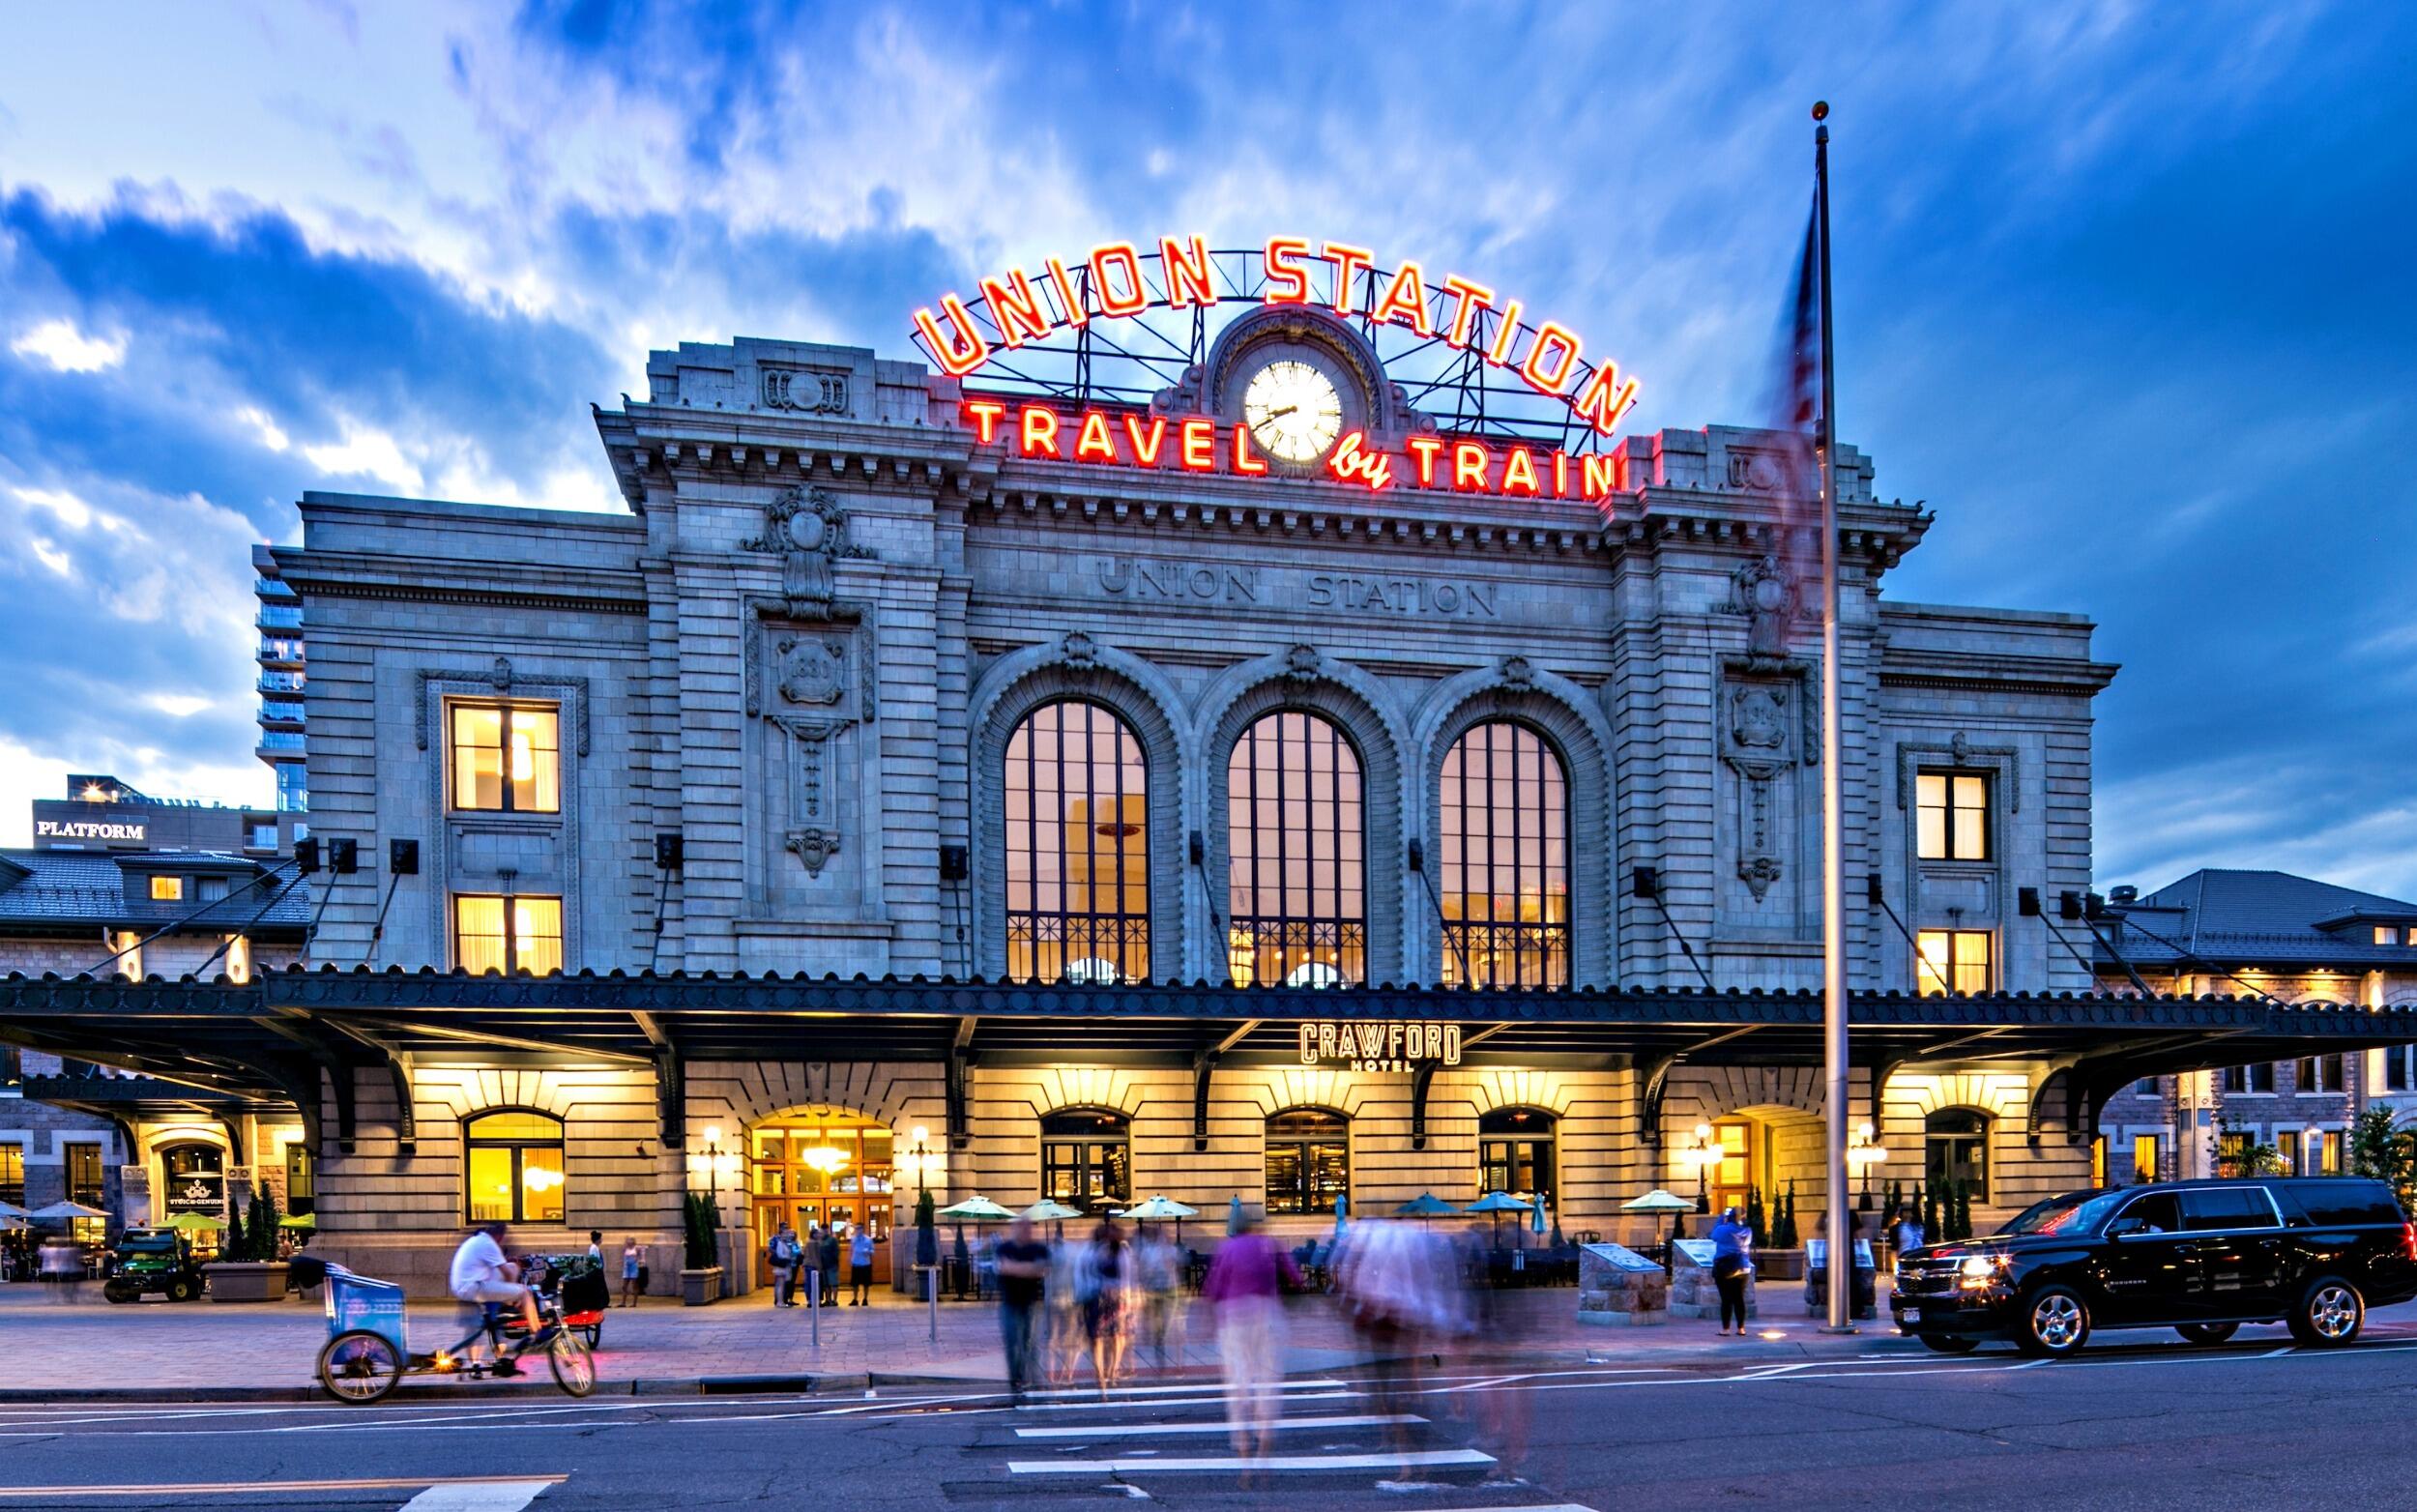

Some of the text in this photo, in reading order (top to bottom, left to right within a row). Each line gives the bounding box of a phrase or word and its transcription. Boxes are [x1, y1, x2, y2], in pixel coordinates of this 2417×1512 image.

[914, 234, 1640, 438] UNION STATION
[966, 400, 1616, 498] TRAVEL by TRAIN
[1097, 561, 1496, 616] UNION STATION
[37, 821, 144, 840] PLATFORM
[1299, 1024, 1461, 1065] CRAWFORD
[1351, 1060, 1414, 1073] HOTEL
